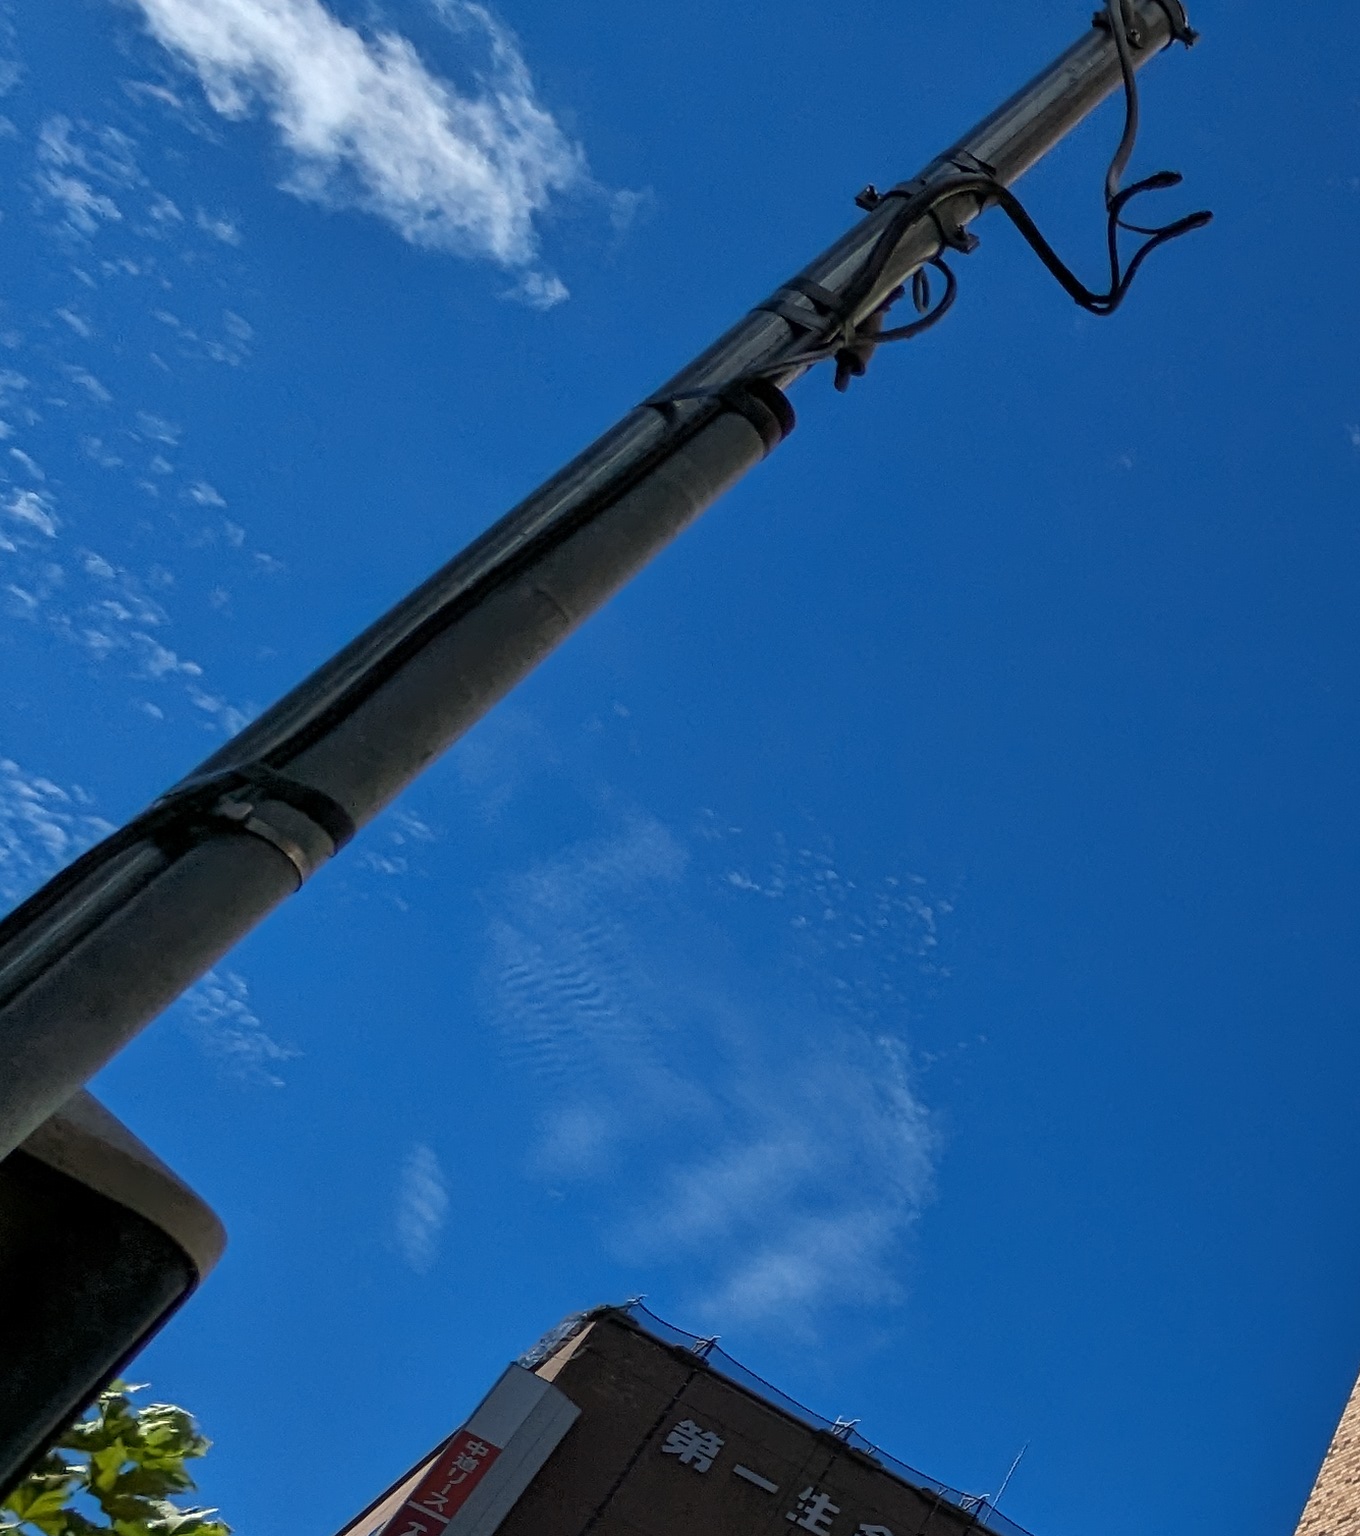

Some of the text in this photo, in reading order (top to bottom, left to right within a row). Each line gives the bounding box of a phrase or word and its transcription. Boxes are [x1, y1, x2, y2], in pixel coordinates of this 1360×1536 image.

[424, 1439, 489, 1513] 中道リース
